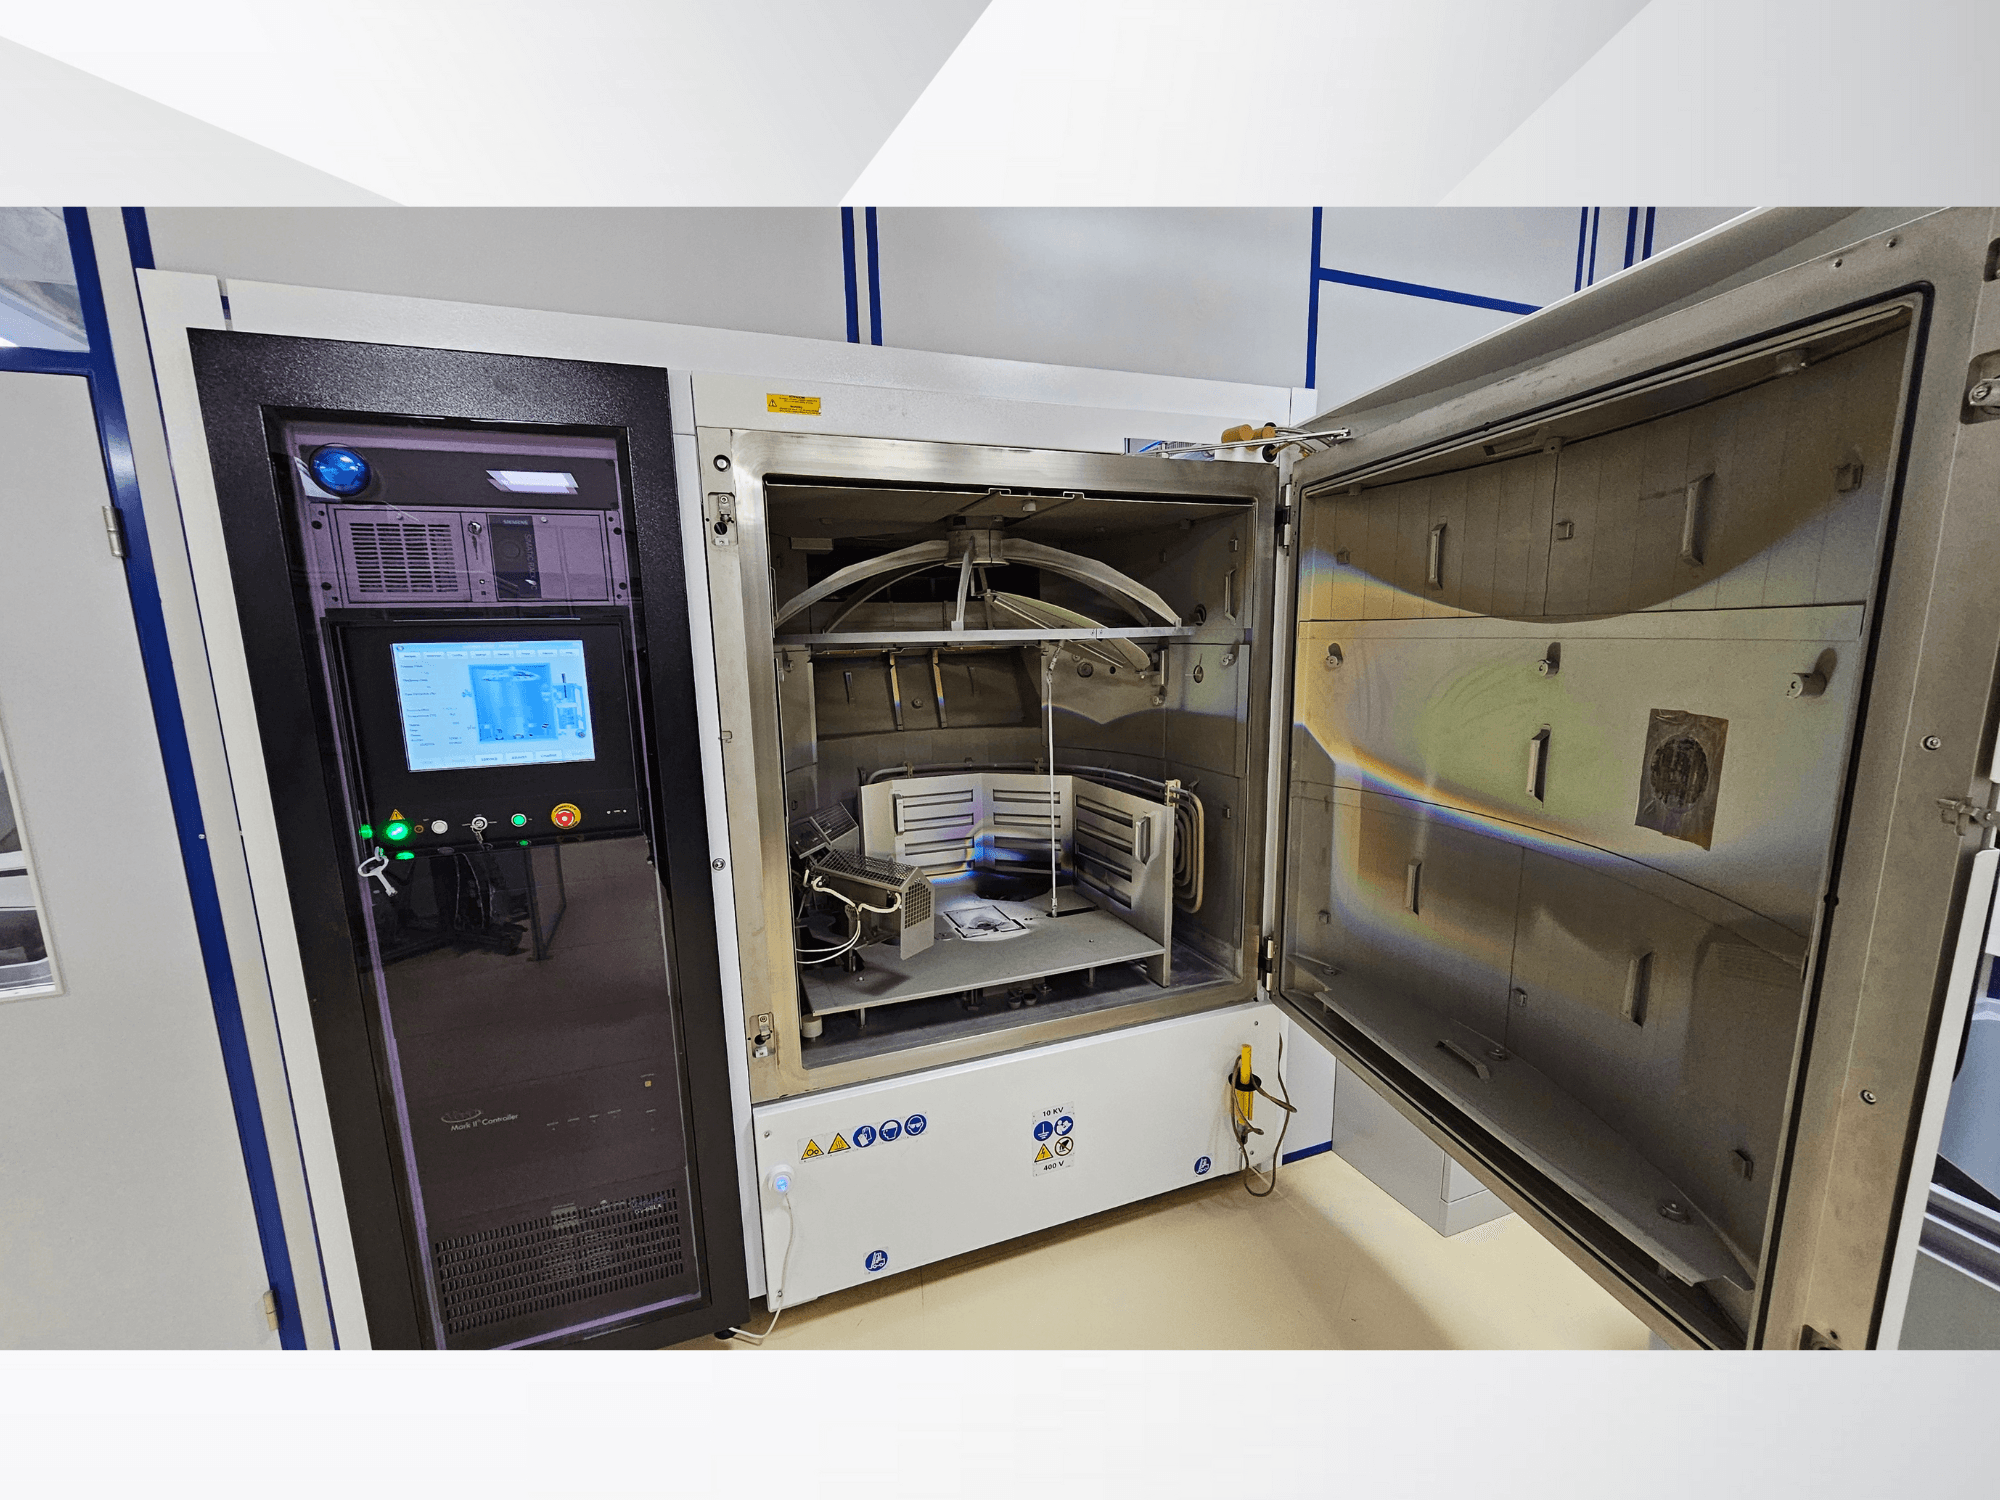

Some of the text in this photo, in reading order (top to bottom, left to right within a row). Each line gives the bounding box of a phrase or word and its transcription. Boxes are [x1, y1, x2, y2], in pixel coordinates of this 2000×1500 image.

[525, 533, 534, 561] SIMATIC
[450, 1122, 471, 1131] Mark
[481, 1114, 518, 1125] Controller
[1043, 1163, 1057, 1171] 400
